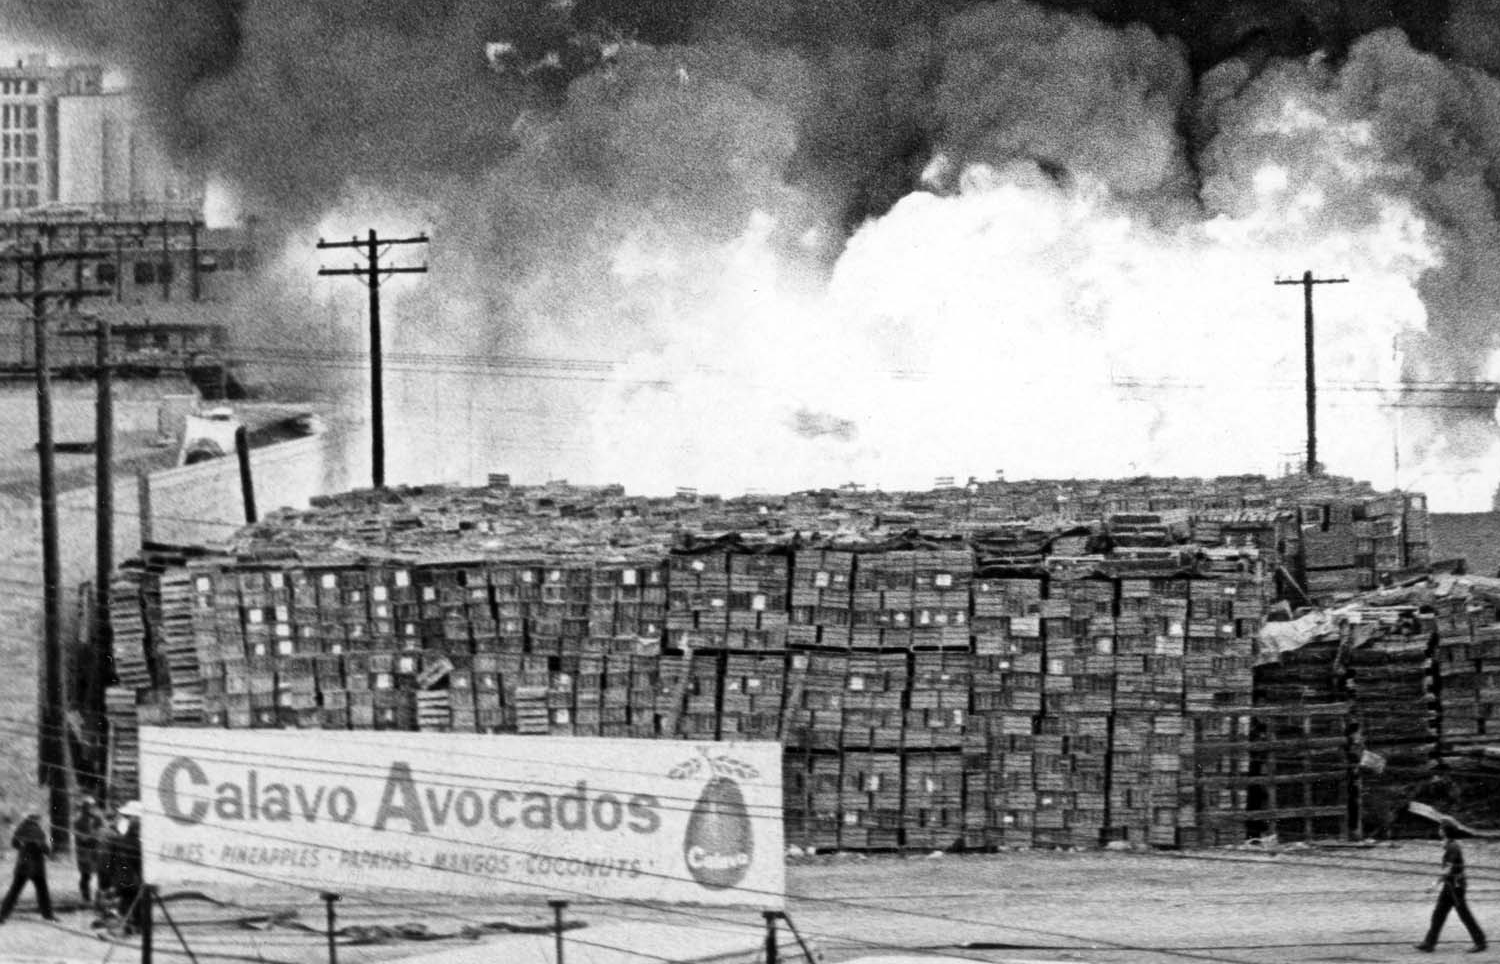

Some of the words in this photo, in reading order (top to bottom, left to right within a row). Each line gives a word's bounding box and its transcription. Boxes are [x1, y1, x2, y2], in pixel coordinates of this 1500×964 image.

[158, 756, 357, 826] Calavo
[372, 761, 661, 834] Avocados
[221, 844, 321, 868] PINEAPPLES
[341, 849, 412, 871] PAPAYAS
[435, 851, 509, 875] MANGOS
[525, 853, 643, 879] COCONUTS
